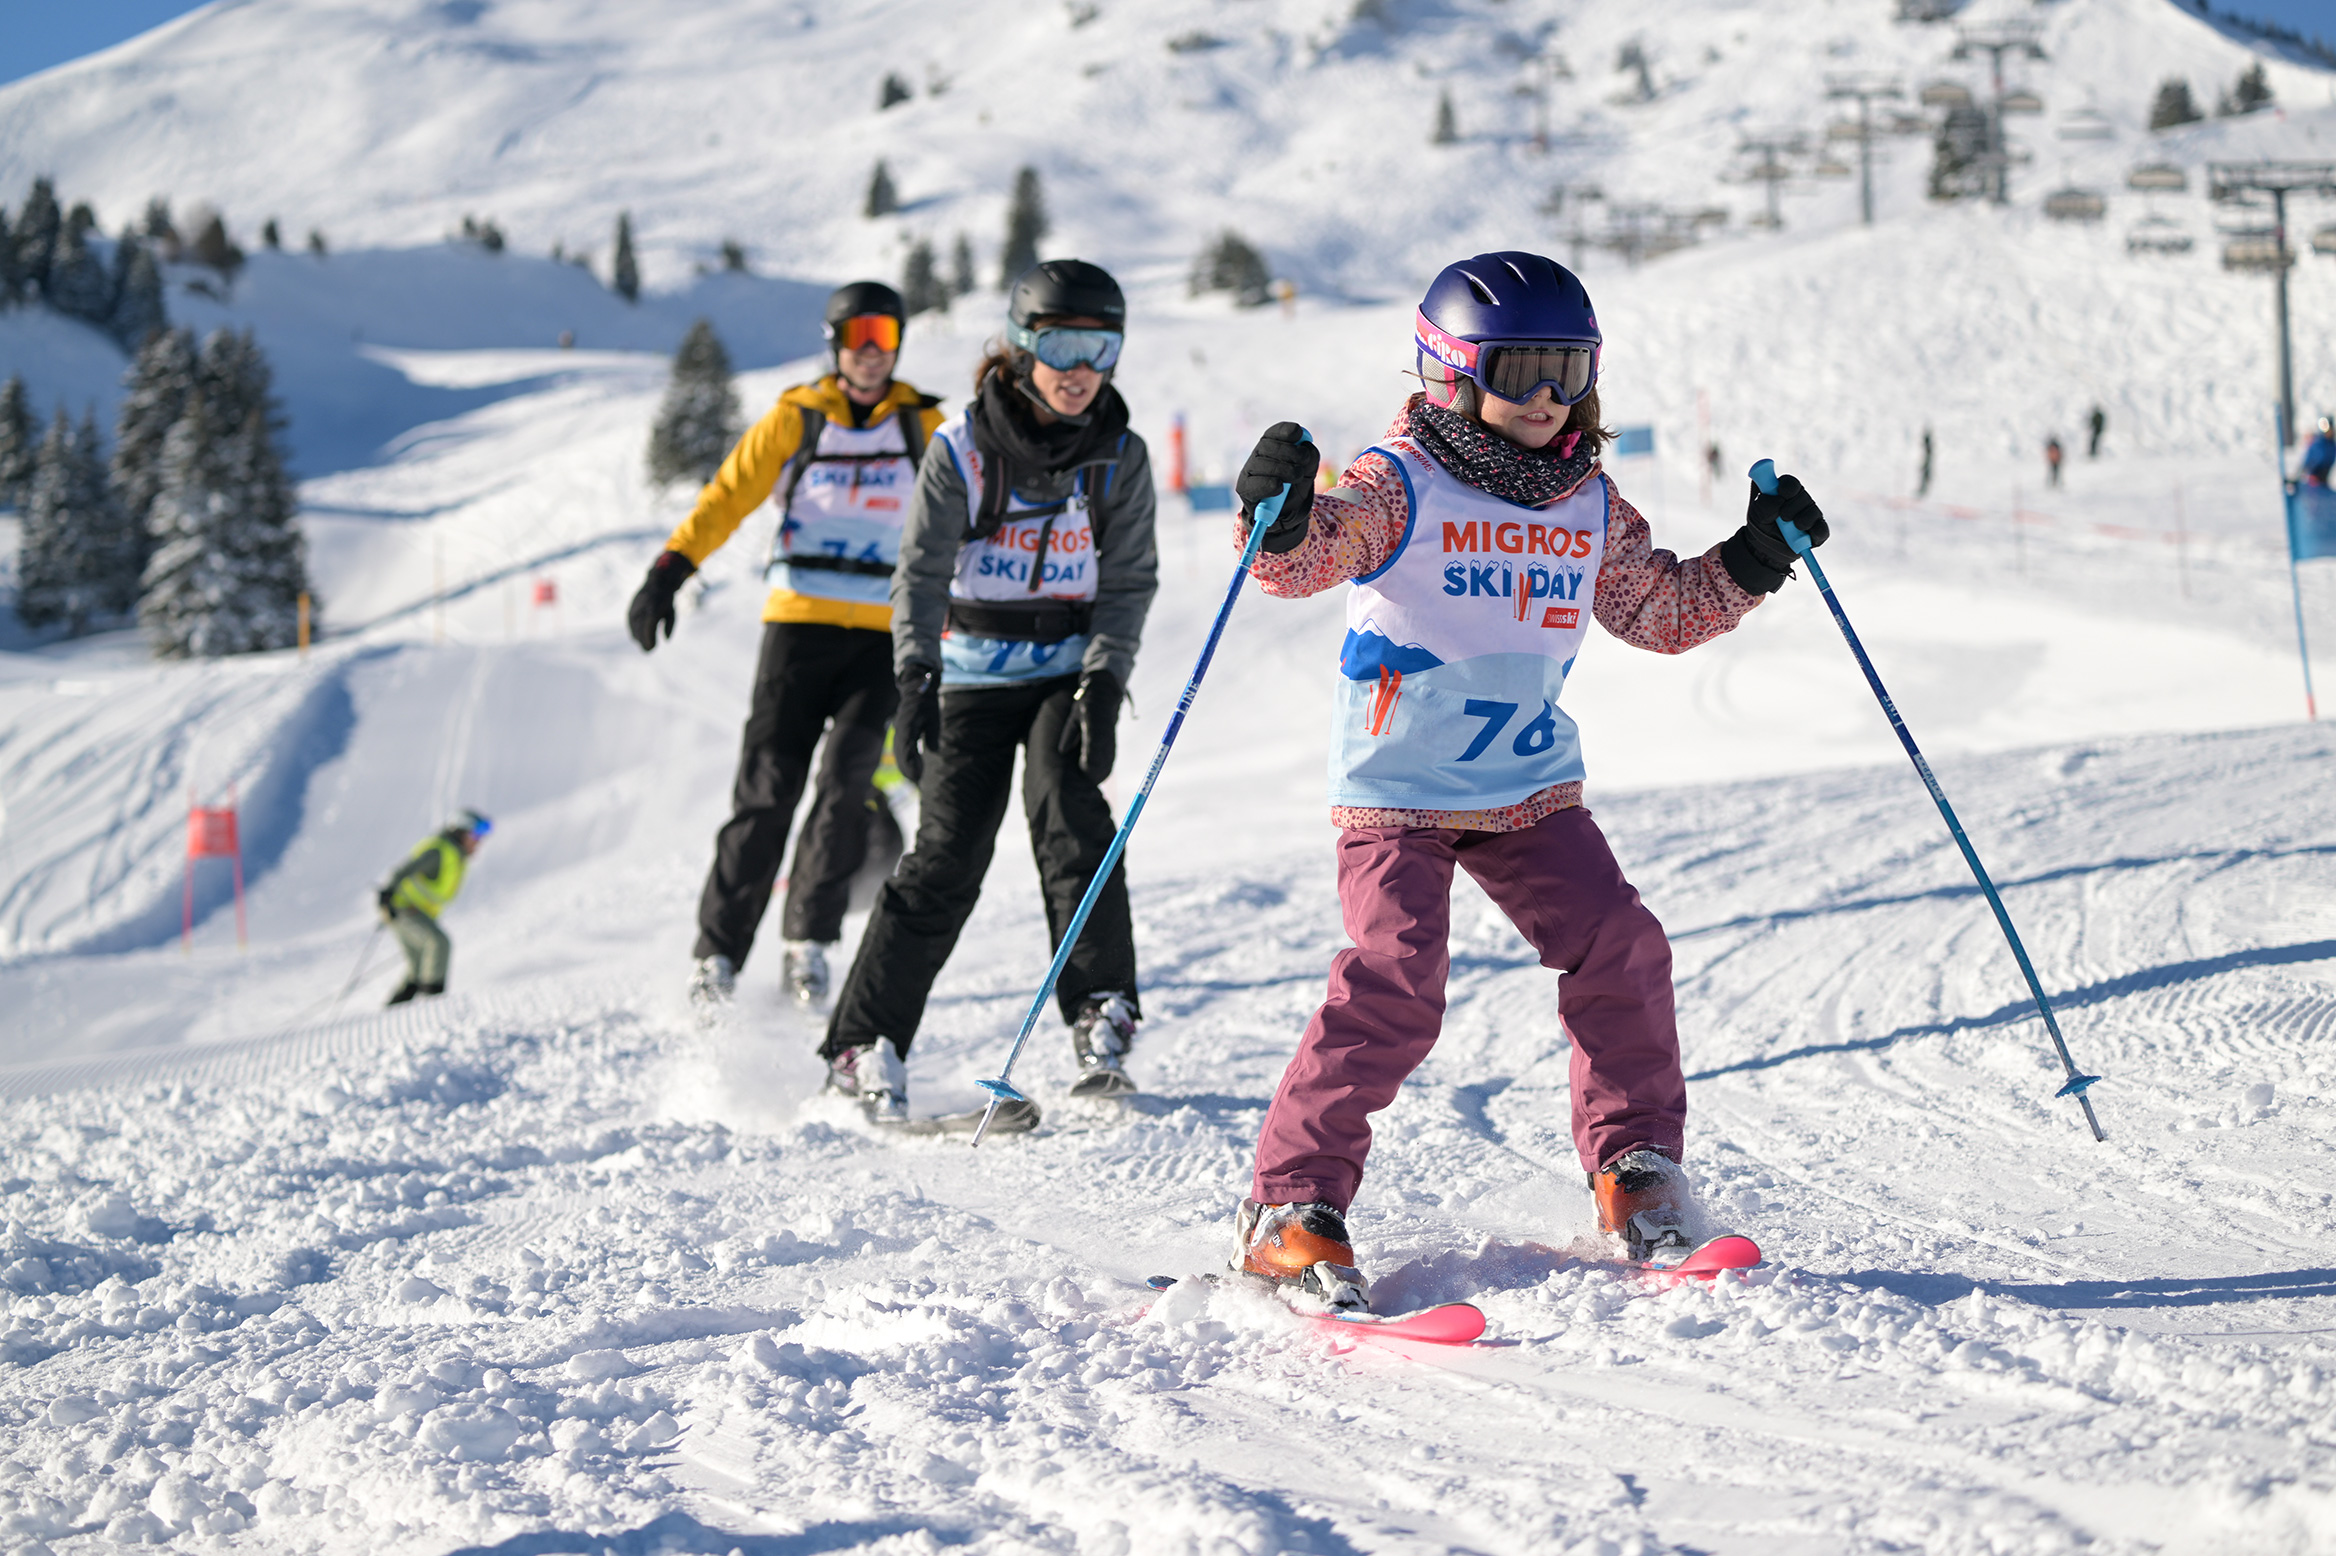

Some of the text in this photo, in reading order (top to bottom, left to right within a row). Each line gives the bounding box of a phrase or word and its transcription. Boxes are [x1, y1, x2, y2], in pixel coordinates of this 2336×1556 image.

[1442, 521, 1593, 559] MIGROS
[978, 554, 1087, 584] SKI DAY
[1442, 559, 1585, 601] SKI DAY
[1454, 698, 1556, 762] 76
